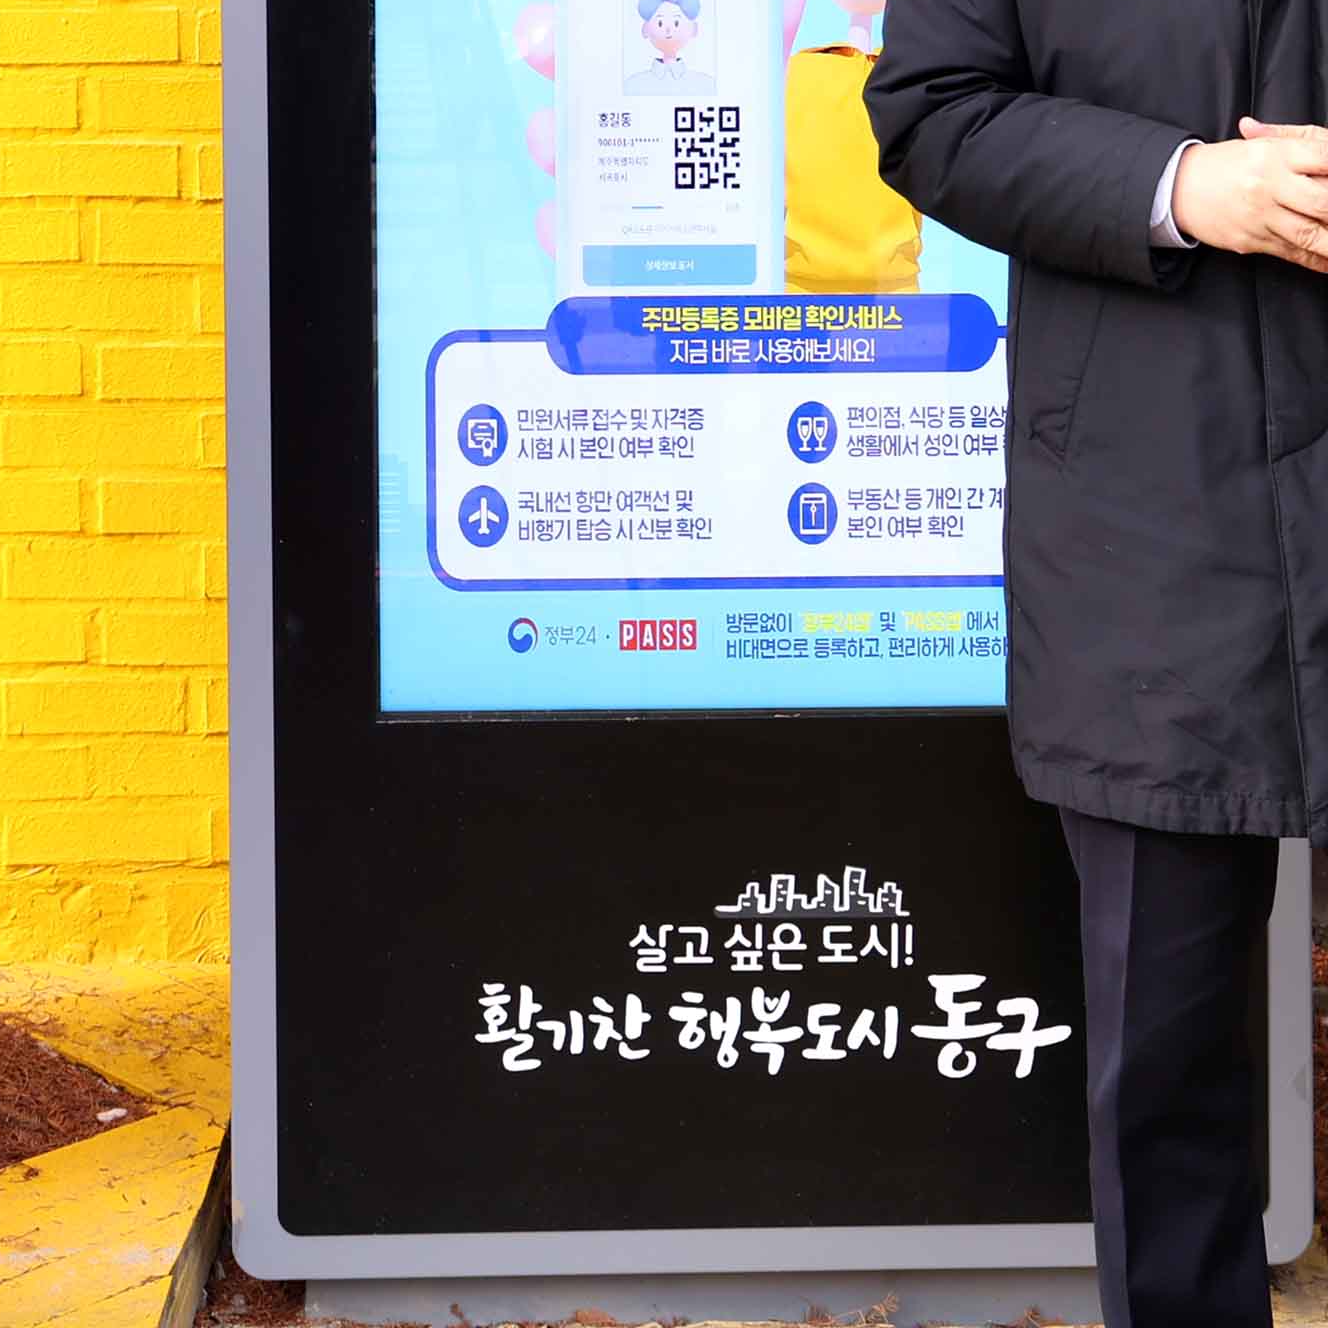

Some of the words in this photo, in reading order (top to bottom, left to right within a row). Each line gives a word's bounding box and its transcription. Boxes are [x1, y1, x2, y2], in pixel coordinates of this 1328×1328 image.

[642, 305, 740, 333] 주민등록증
[743, 304, 803, 332] 모바일
[805, 303, 904, 332] 확인서비스
[670, 338, 708, 365] 지금
[712, 338, 751, 364] 바로
[754, 337, 875, 365] 사용해보세요!
[517, 408, 589, 432] 민원서류
[591, 408, 627, 432] 접수
[630, 408, 648, 432] 및
[652, 407, 705, 432] 자격증
[908, 405, 945, 429] 식당
[948, 405, 966, 429] 등
[970, 405, 1008, 429] 일상
[517, 436, 553, 460] 시험
[557, 436, 575, 460] 시
[579, 436, 615, 460] 본인
[618, 435, 654, 460] 여부
[658, 435, 695, 459] 확인
[847, 434, 919, 458] 생활에서
[924, 433, 959, 457] 성인
[963, 433, 999, 457] 여부
[518, 490, 571, 514] 국내선
[575, 489, 612, 514] 항만
[616, 489, 670, 513] 여객선
[675, 489, 693, 513] 및
[847, 487, 901, 511] 부동산
[904, 487, 923, 511] 등
[926, 487, 962, 511] 개인
[967, 487, 984, 510] 간
[518, 519, 571, 543] 비행기
[575, 518, 612, 542] 탑승
[616, 518, 633, 542] 시
[637, 518, 672, 541] 신분
[676, 517, 712, 541] 확인
[847, 515, 883, 539] 본인
[887, 515, 923, 539] 여부
[927, 514, 965, 538] 확인
[726, 611, 793, 634] 방문없이
[879, 610, 896, 633] 및
[966, 610, 1000, 632] 에서
[544, 625, 597, 646] 정부24
[621, 622, 694, 649] PASS
[726, 637, 809, 660] 비대면으로
[813, 637, 884, 660] 등록하고,
[888, 636, 955, 659] 편리하게
[628, 922, 714, 973] 살고
[724, 921, 808, 972] 싶은
[817, 921, 914, 969] 도시!
[474, 982, 652, 1072] 활기찬
[668, 985, 901, 1075] 행복도시
[910, 973, 1073, 1079] 동구
